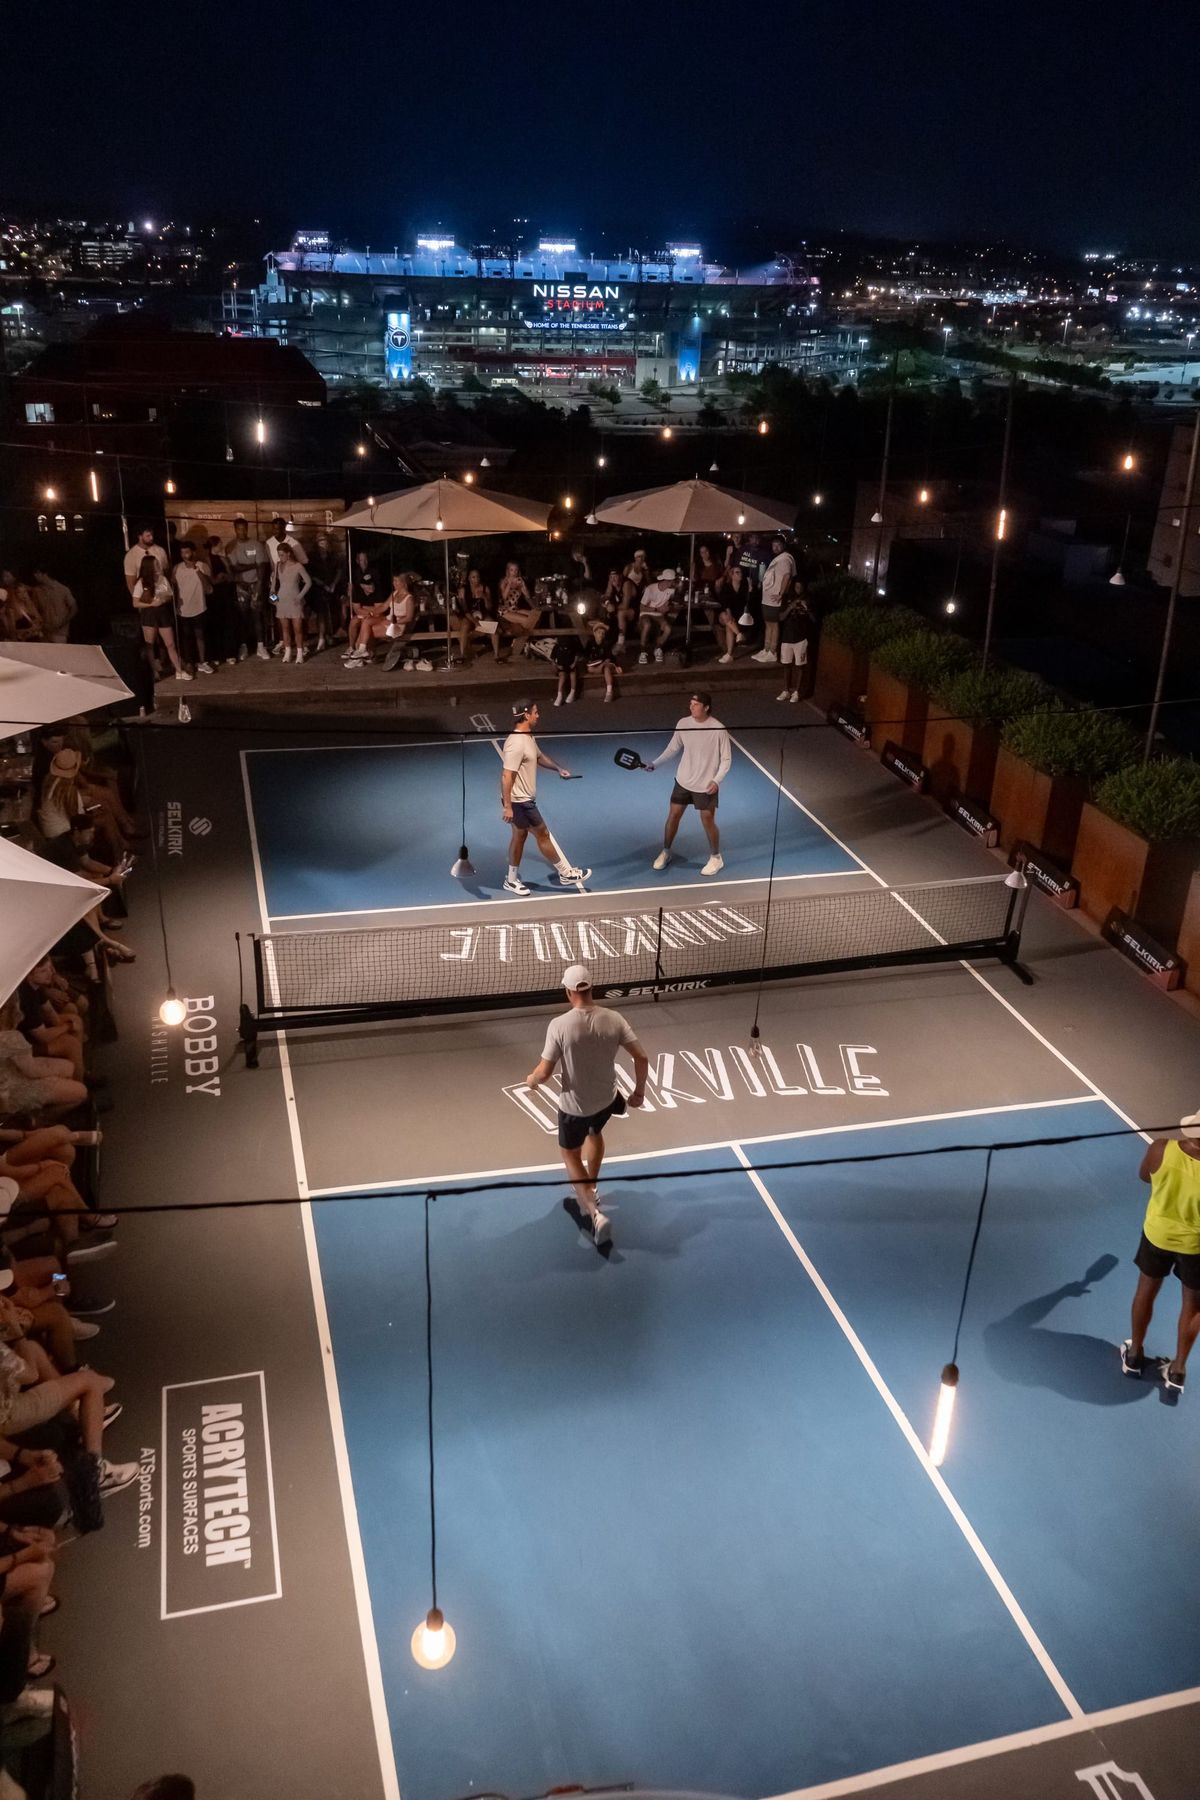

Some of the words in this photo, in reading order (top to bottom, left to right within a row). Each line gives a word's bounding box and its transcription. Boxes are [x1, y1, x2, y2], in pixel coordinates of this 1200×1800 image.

[533, 284, 619, 299] NISSAN
[547, 300, 604, 309] STADIUM
[894, 758, 921, 783] SELKIRK
[167, 801, 183, 855] SELKIRK
[958, 806, 986, 834] SELKIRK
[1123, 934, 1166, 973] SELKIRK
[628, 980, 708, 997] SELKIRK
[182, 995, 222, 1097] BOBBY
[501, 1043, 890, 1135] DKVILLE
[182, 1428, 197, 1479] SPORTS
[138, 1447, 155, 1548] ATSports.com
[201, 1402, 252, 1568] ACRYTECH
[182, 1480, 199, 1555] SURFACES
